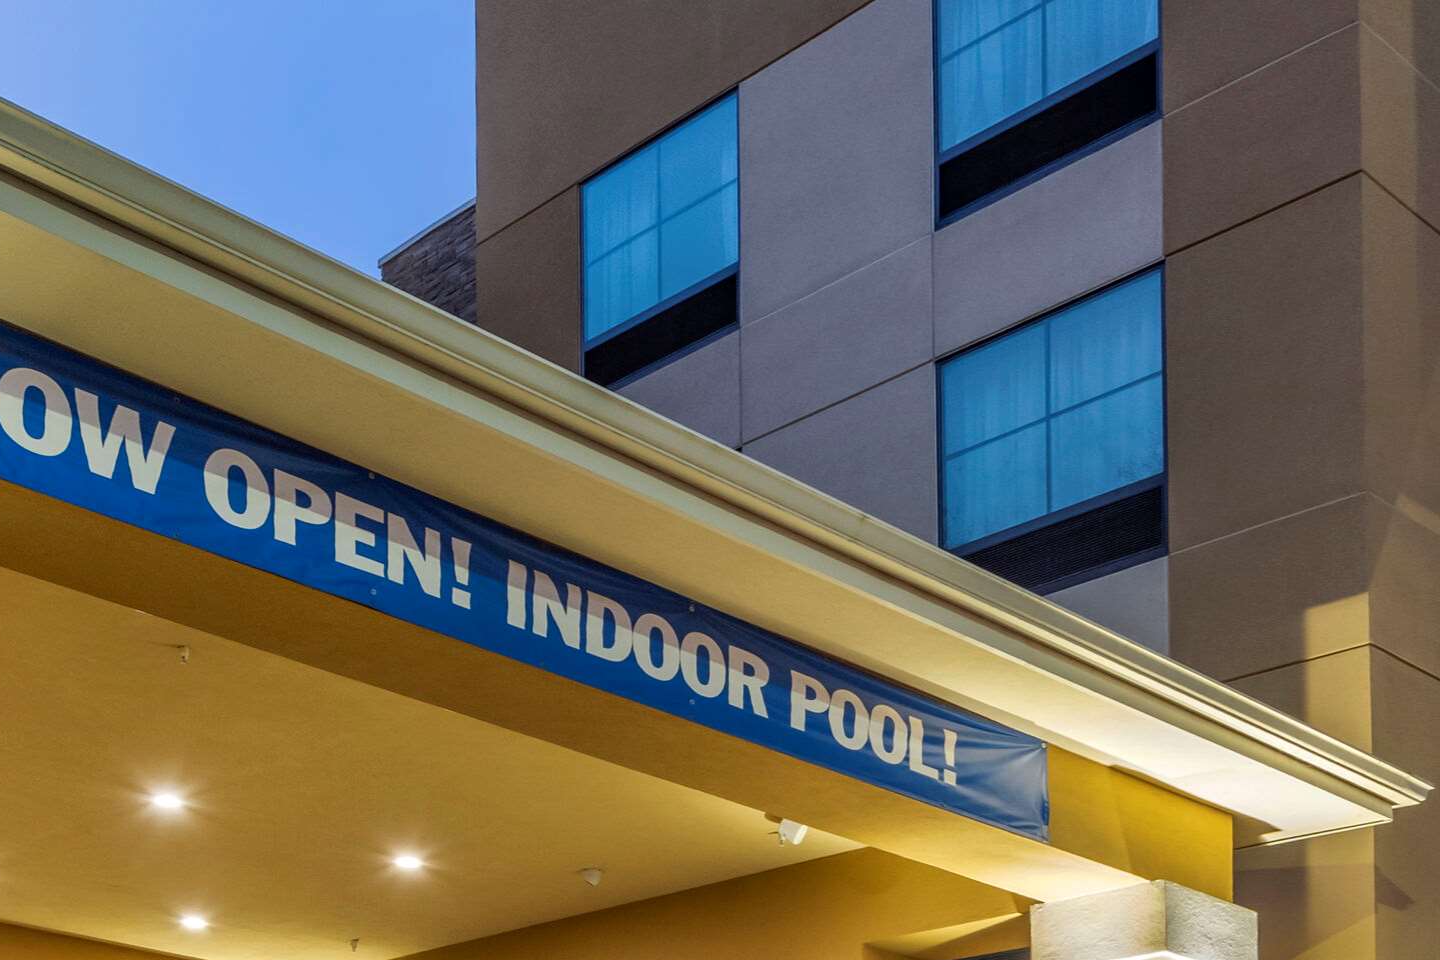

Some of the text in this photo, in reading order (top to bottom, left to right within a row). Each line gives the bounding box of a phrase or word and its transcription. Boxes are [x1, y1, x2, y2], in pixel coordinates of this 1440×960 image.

[203, 448, 472, 609] OPEN!
[506, 559, 770, 719] INDOOR
[789, 669, 957, 786] POOL!
